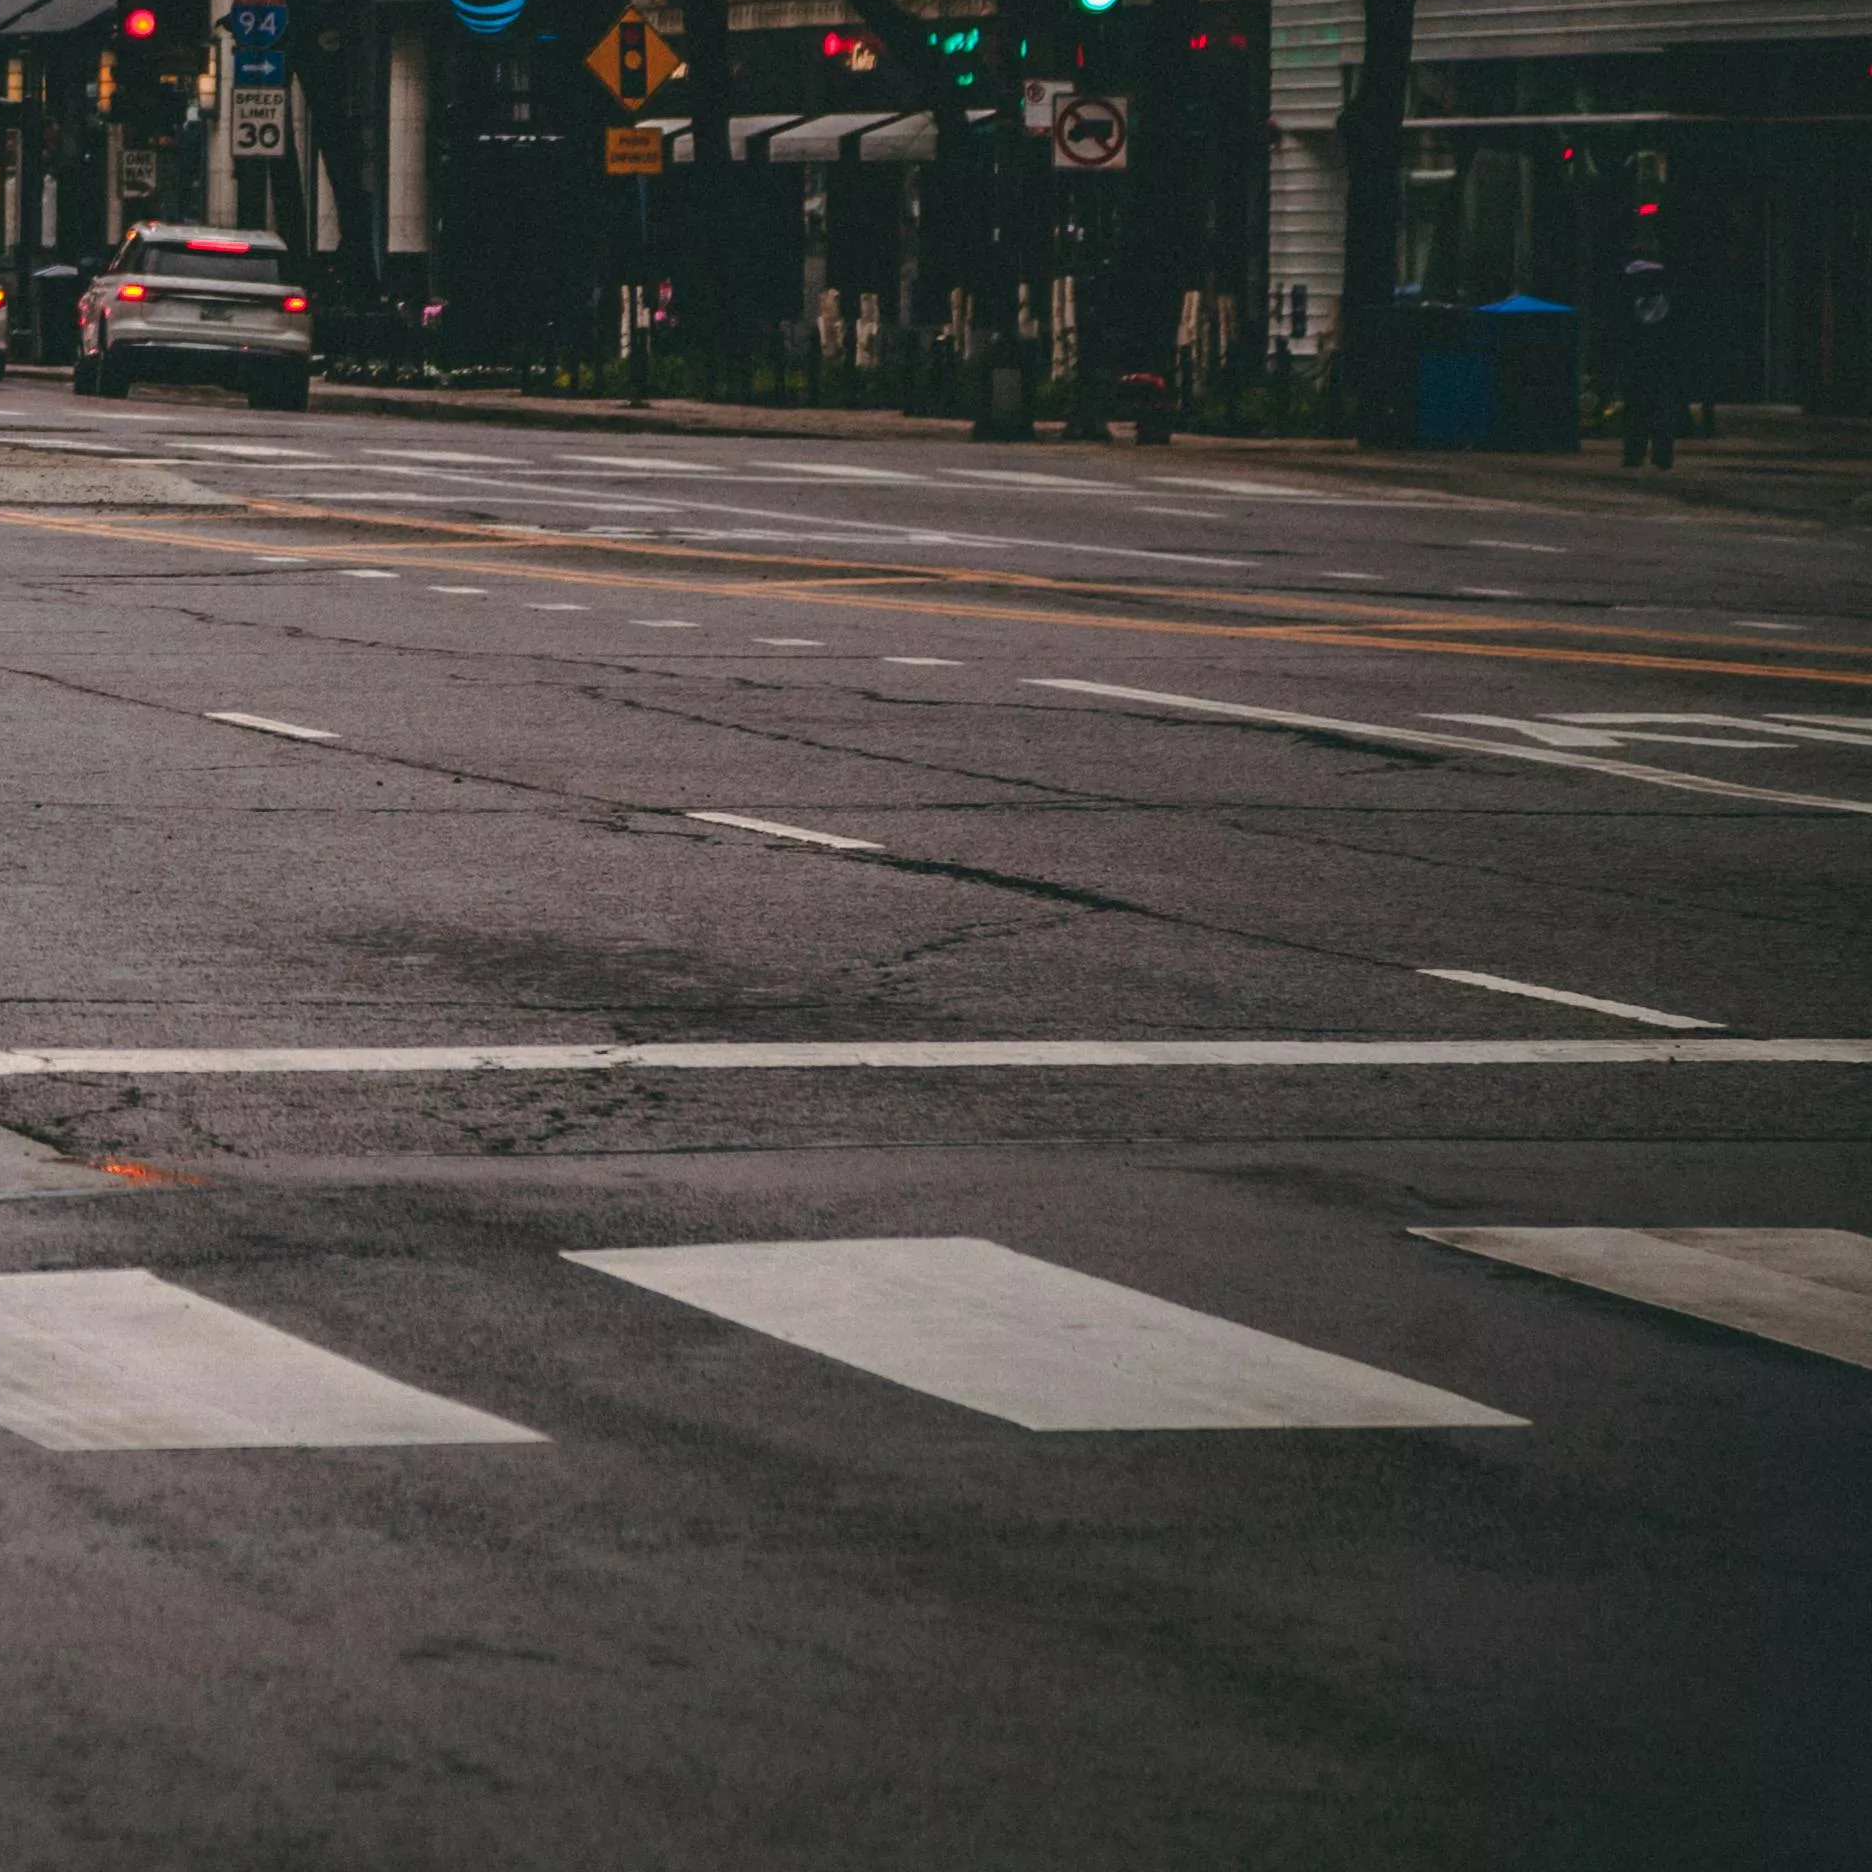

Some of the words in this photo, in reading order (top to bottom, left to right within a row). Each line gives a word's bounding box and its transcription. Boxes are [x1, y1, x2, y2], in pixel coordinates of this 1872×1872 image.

[238, 11, 277, 36] 94
[235, 94, 284, 105] SPEED
[239, 108, 277, 119] LIMIT
[236, 123, 281, 149] 30
